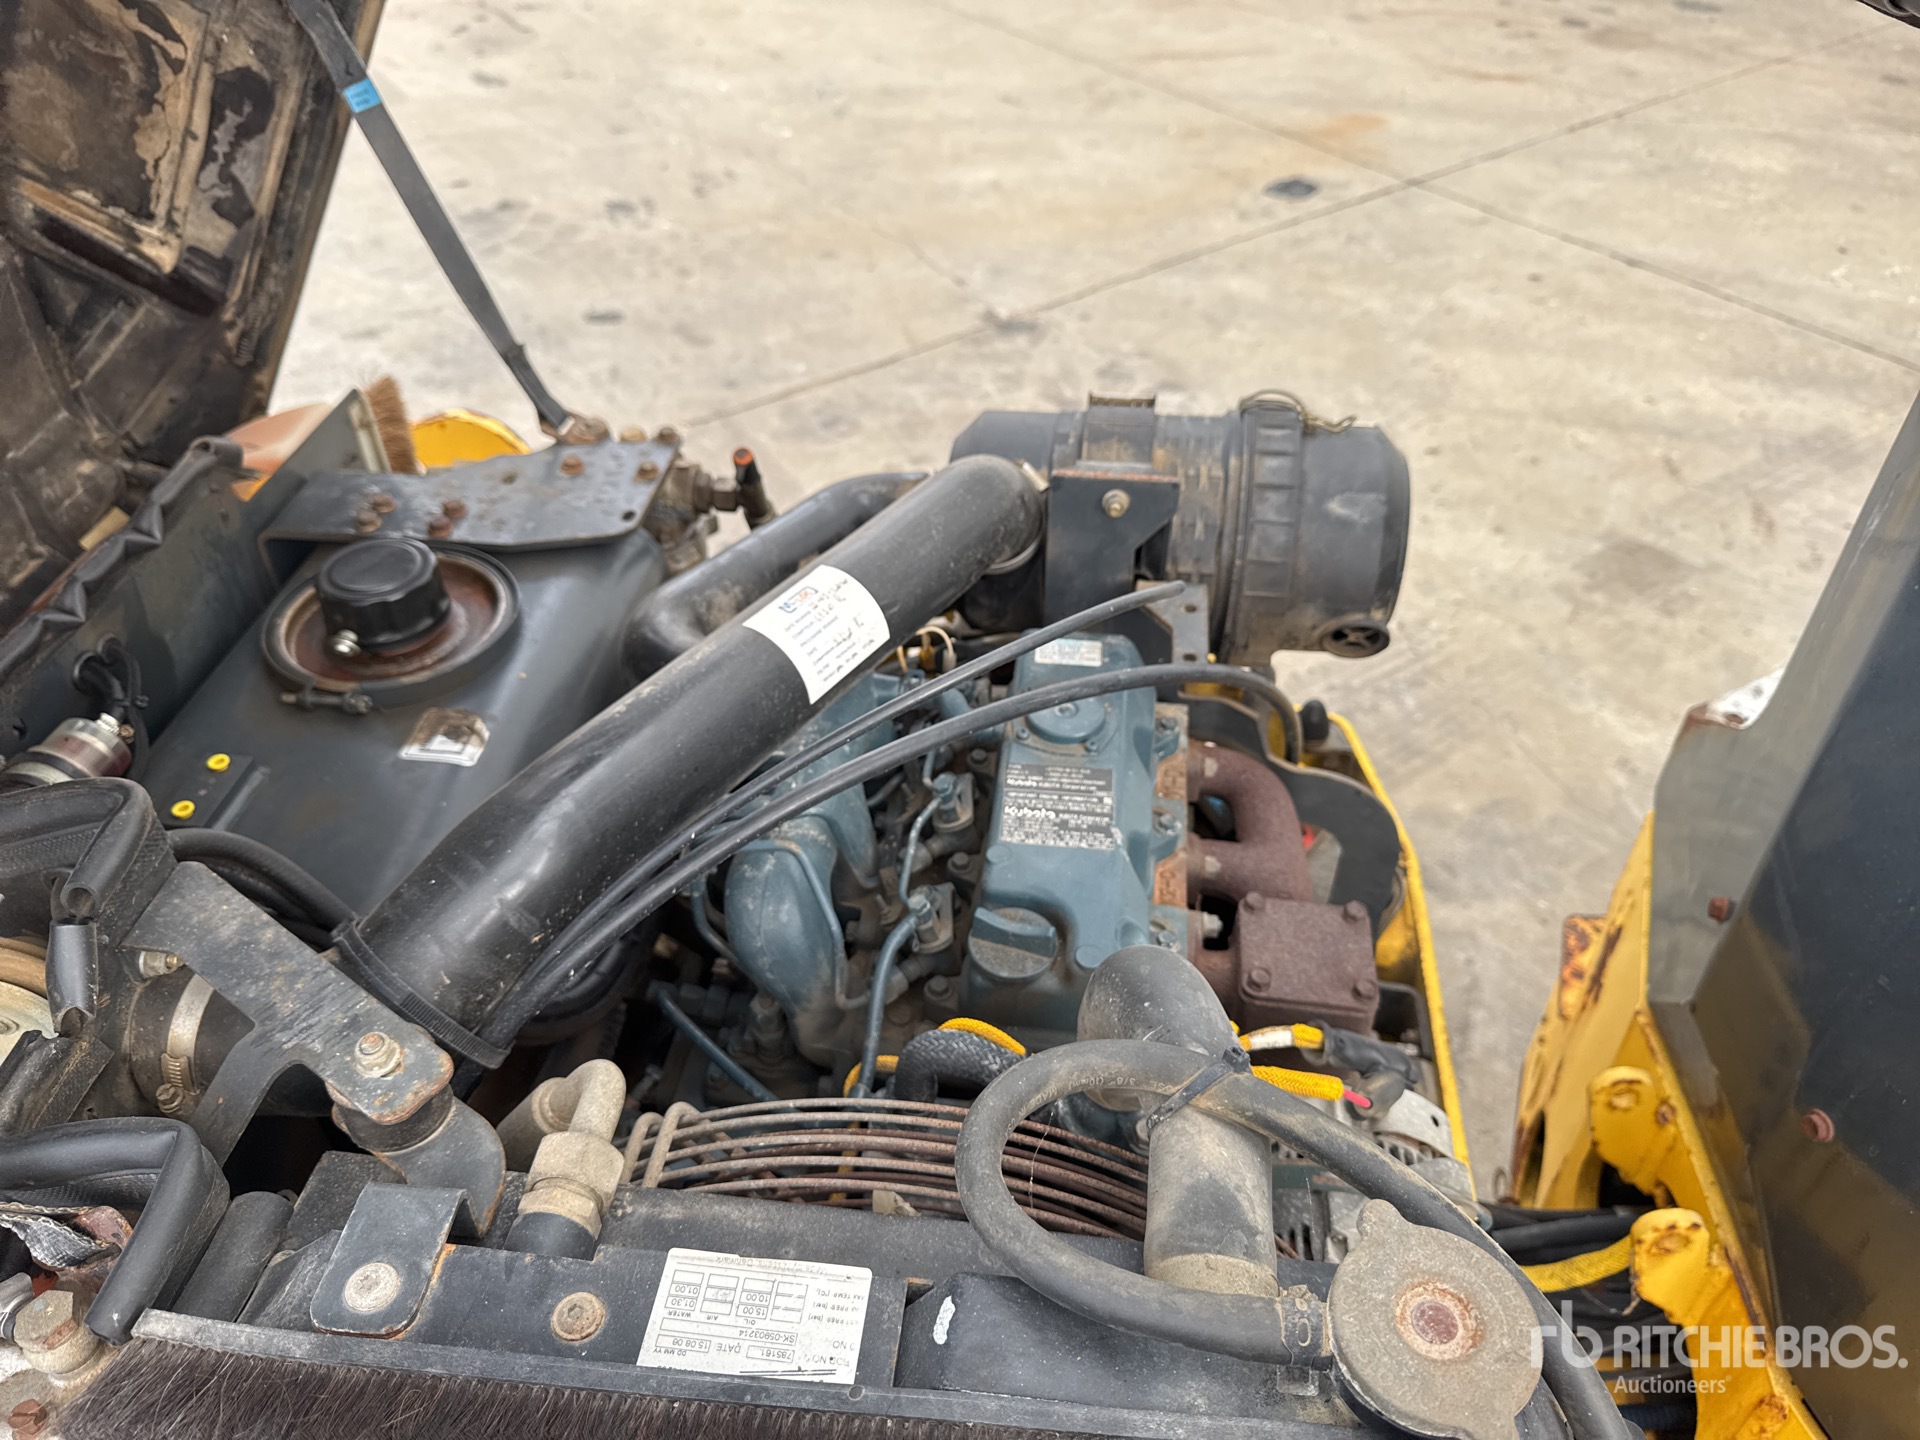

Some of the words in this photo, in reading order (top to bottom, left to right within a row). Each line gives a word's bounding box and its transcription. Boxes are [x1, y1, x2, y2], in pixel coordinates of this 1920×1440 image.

[1004, 806, 1056, 820] Kubota
[716, 1256, 754, 1267] Denmark
[668, 1310, 692, 1318] WATER
[716, 1342, 742, 1354] DATE
